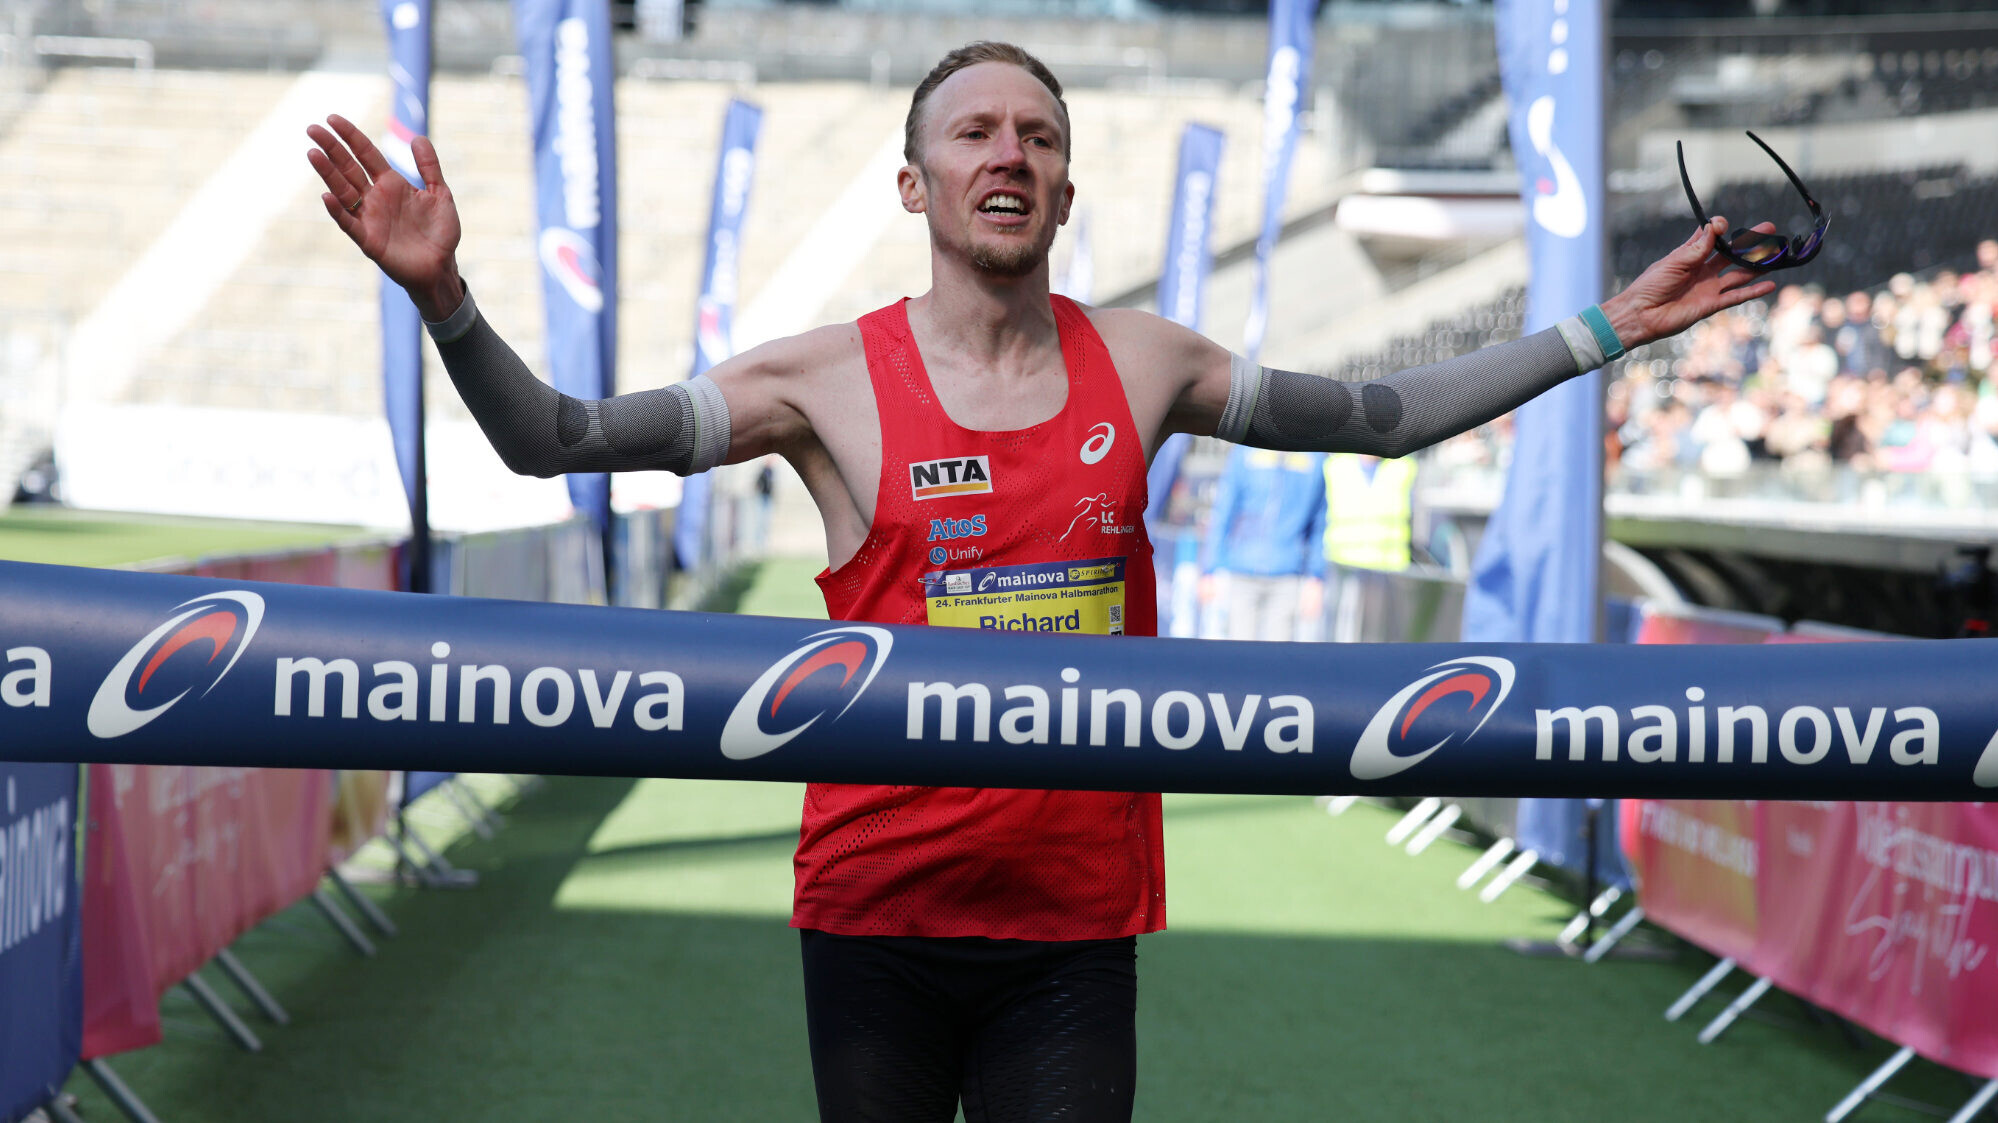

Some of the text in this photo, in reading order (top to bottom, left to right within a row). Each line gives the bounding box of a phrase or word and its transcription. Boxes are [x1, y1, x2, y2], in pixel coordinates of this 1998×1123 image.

[912, 459, 988, 488] NTA
[1101, 511, 1114, 524] LC
[949, 546, 984, 561] Unify
[997, 571, 1065, 588] mainova
[935, 586, 1119, 608] 24. Frankfurter Mainova Halbmarathon
[979, 609, 1080, 632] Richard
[274, 641, 686, 731] mainova
[906, 667, 1314, 754] mainova
[1535, 686, 1941, 766] mainova
